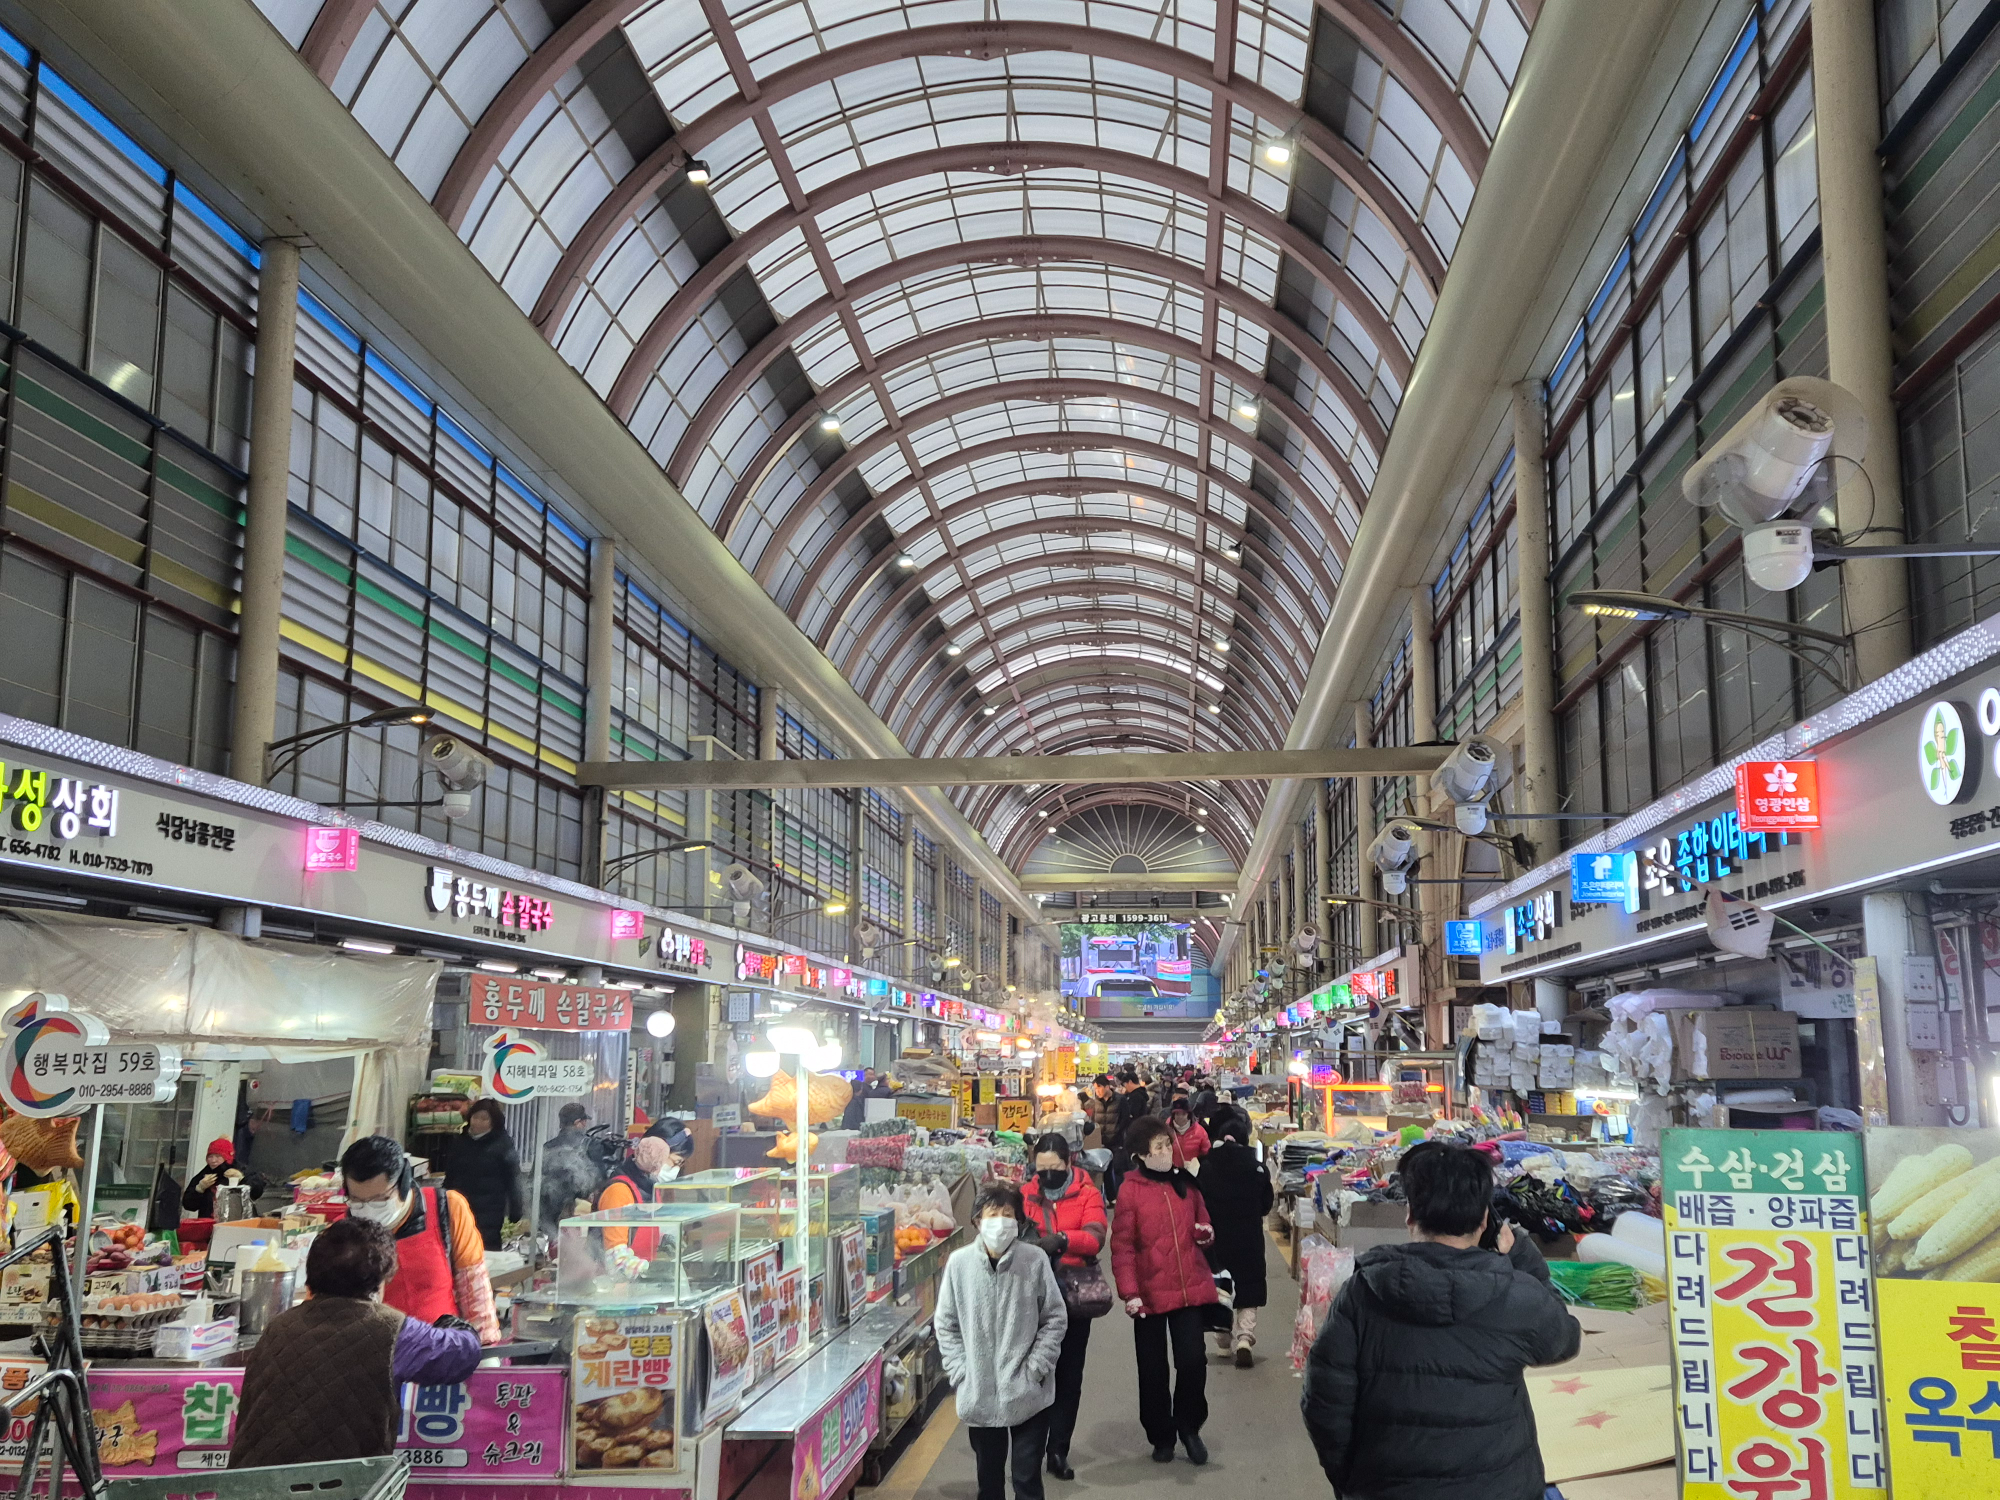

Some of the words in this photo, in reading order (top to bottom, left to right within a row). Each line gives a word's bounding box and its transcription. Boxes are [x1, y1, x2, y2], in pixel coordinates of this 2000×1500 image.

[1755, 797, 1811, 812] 영광인삼
[156, 812, 235, 852] 식당납품전문
[10, 839, 61, 861] 656-4782
[83, 852, 153, 876] 010-7529-7879
[1676, 811, 1788, 892] 종합인테
[455, 877, 499, 919] 홍두깨
[502, 891, 555, 932] 손칼국수
[1517, 890, 1556, 942] 조은상회
[1081, 914, 1117, 923] 광고문의
[1122, 914, 1168, 922] 1599-3611
[483, 979, 546, 1023] 홍두깨
[556, 990, 625, 1026] 손칼국수
[34, 1052, 107, 1076] 행복맛집
[118, 1052, 155, 1073] 59호
[506, 1065, 557, 1079] 지해네과일
[563, 1065, 585, 1077] 58호
[79, 1082, 152, 1098] 010-2954-8886
[1002, 1105, 1029, 1119] 캡틴
[1679, 1194, 1736, 1226] 배즙
[1768, 1195, 1858, 1230] 양파즙
[629, 1335, 672, 1357] 명품
[1674, 1233, 1719, 1482] 다려드립니다
[583, 1358, 671, 1388] 계란빵
[1835, 1236, 1886, 1487] 다려드립니다
[496, 1383, 535, 1408] 통팥
[507, 1412, 521, 1434] &
[483, 1441, 542, 1465] 슈크림
